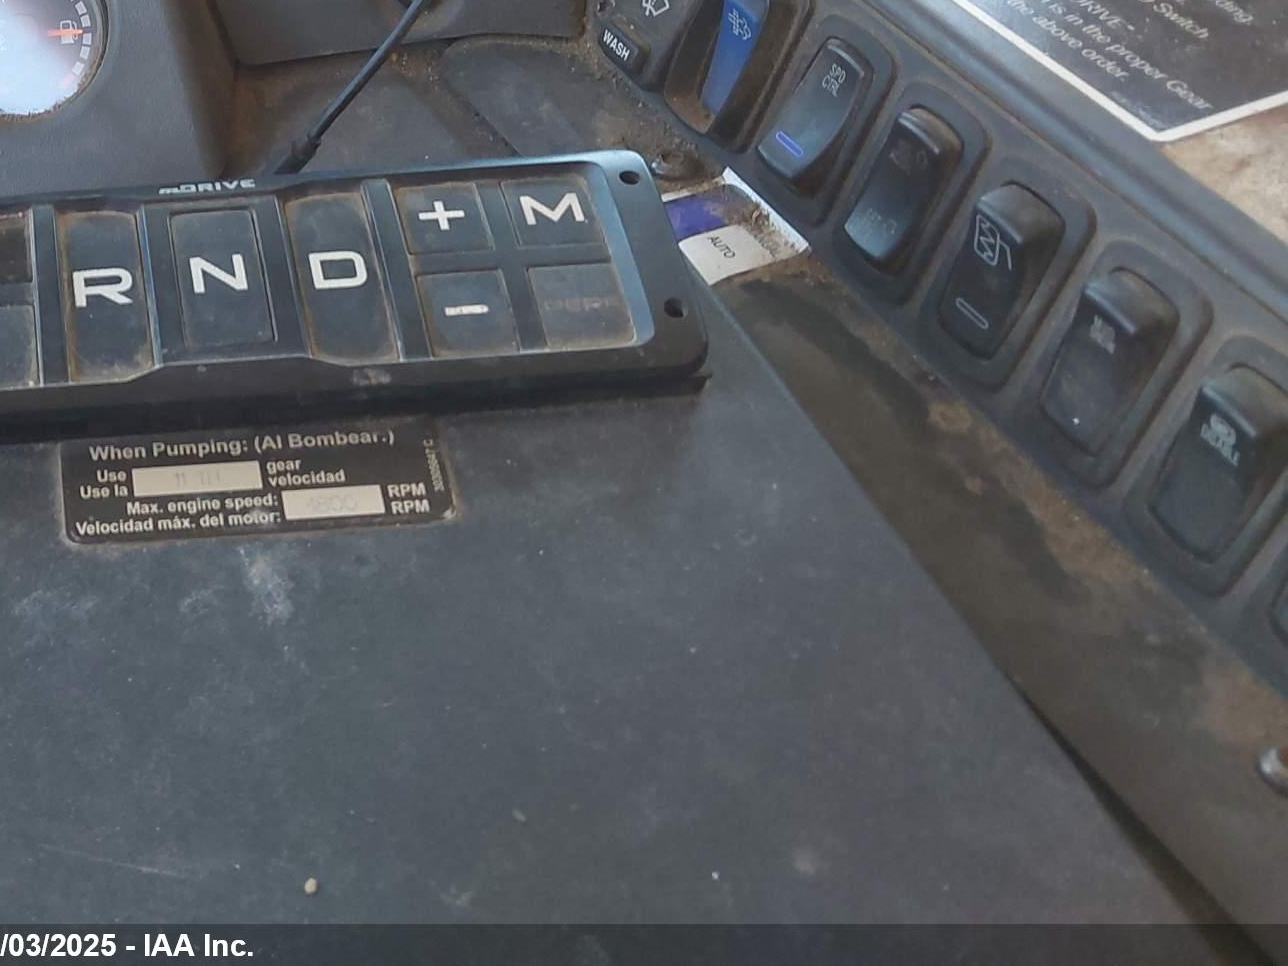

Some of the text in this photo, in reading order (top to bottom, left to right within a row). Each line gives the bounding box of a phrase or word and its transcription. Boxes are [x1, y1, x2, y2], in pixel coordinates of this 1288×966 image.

[1149, 1, 1216, 39] Switch
[603, 29, 631, 62] WASH
[1028, 13, 1090, 50] above
[1077, 46, 1137, 82] order.
[1046, 2, 1072, 14] is
[1062, 12, 1089, 25] in
[1079, 23, 1117, 44] the
[1102, 42, 1171, 82] proper
[1159, 77, 1219, 111] Gear
[519, 192, 585, 226] M
[709, 235, 736, 259] AUTO
[188, 253, 249, 294] N
[309, 250, 368, 290] D
[73, 267, 133, 309] R
[89, 444, 146, 462] When
[152, 439, 248, 458] Pumping:
[254, 433, 281, 454] (Al
[80, 468, 346, 499] Use la velocidad
[96, 459, 302, 483] Use gear
[126, 482, 426, 516] Max. engine speed: RPM
[76, 499, 430, 536] Velocidad máx. del motor: RPM
